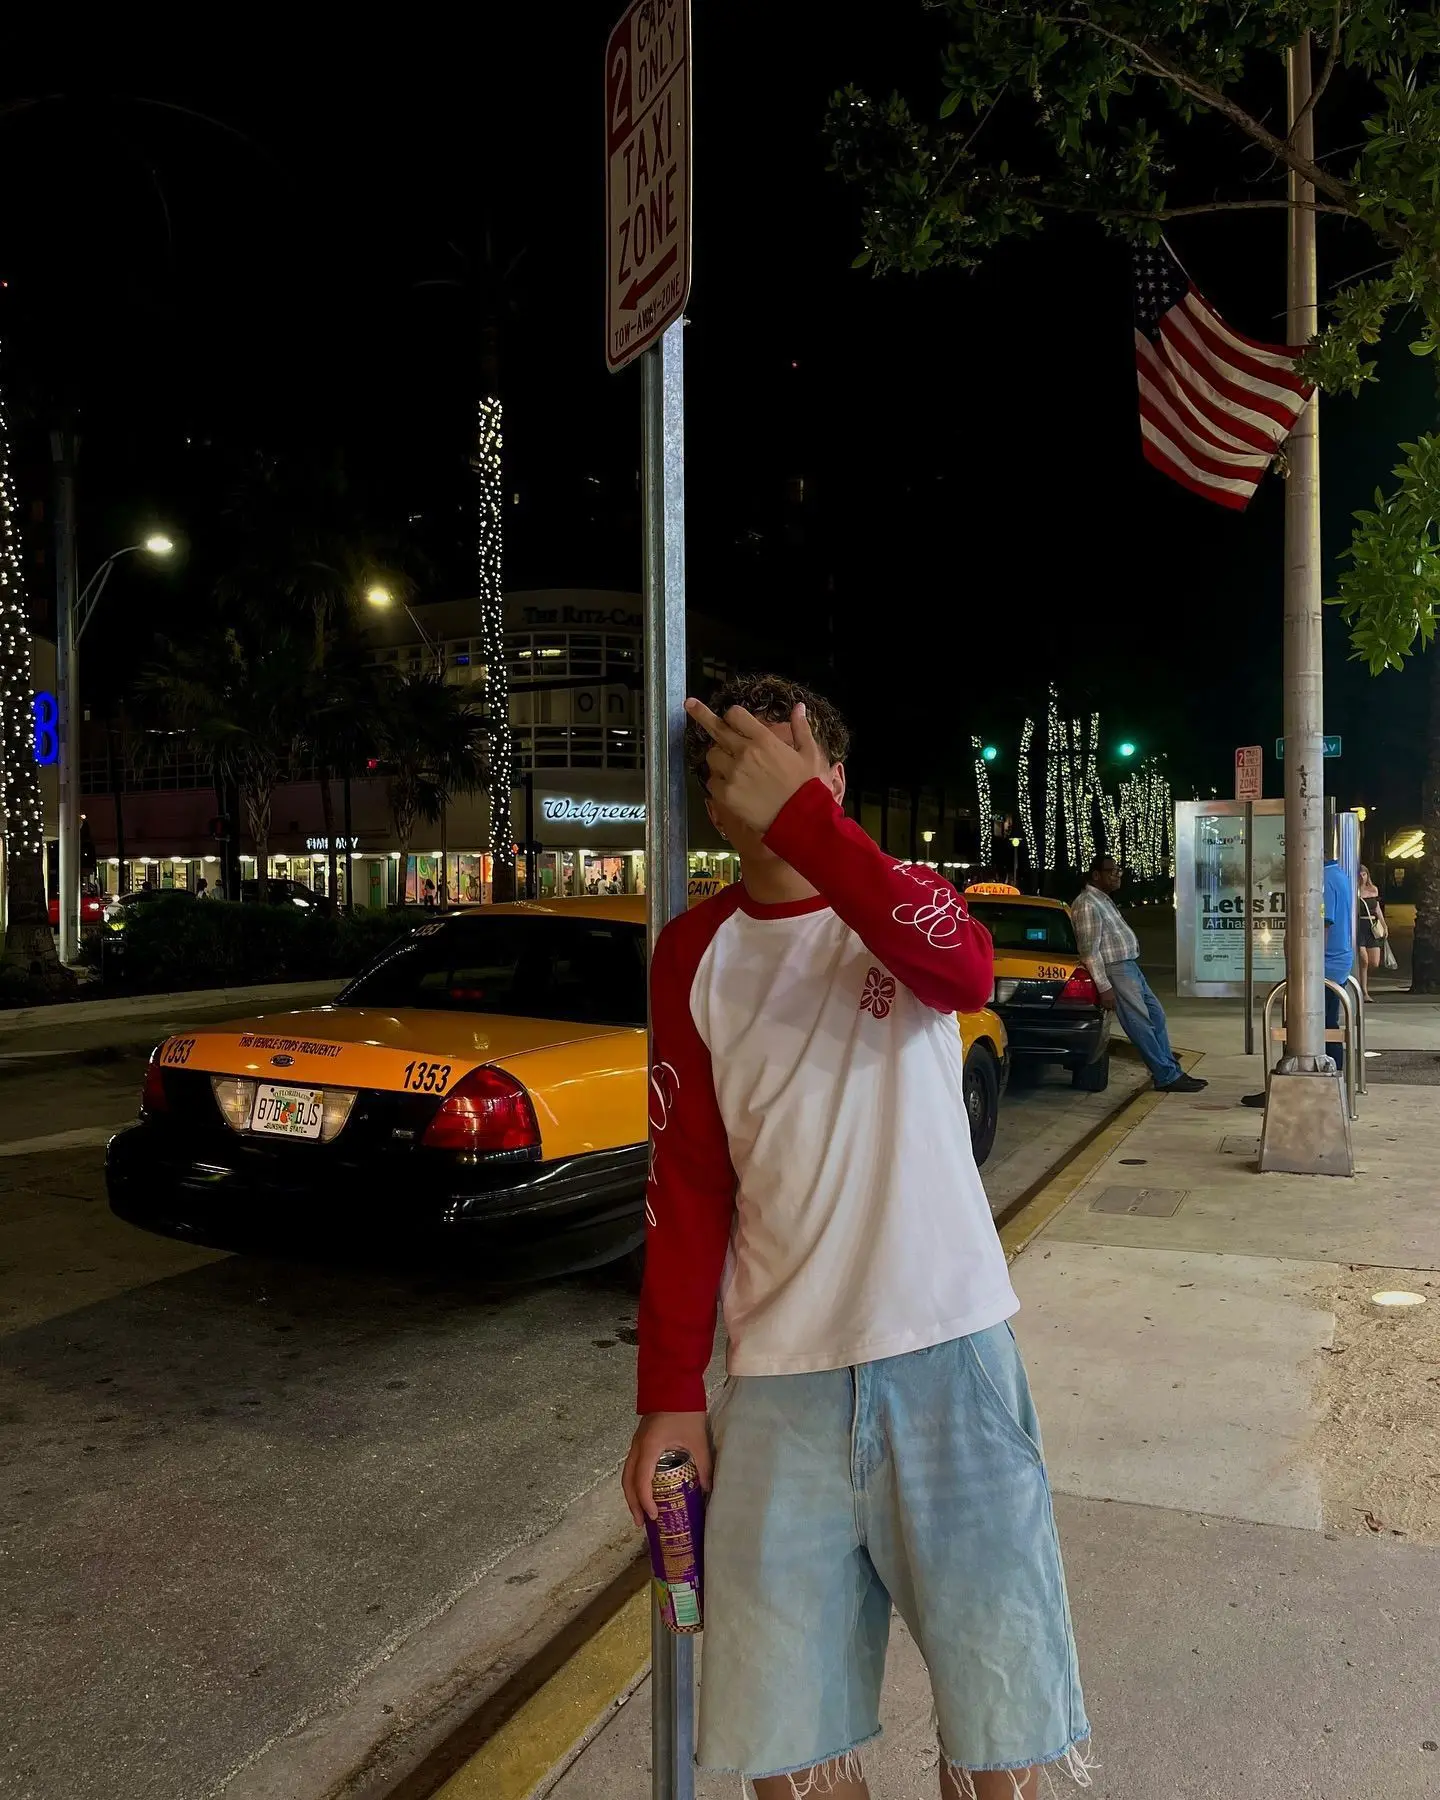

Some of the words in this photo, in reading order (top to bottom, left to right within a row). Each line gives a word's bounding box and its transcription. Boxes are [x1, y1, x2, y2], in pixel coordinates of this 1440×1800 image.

[638, 0, 674, 52] CAB
[638, 11, 677, 103] ONLY
[611, 46, 628, 134] 2
[623, 90, 672, 207] TAXI
[618, 162, 678, 285] ZONE
[614, 271, 681, 352] TOW-AWAY-ZONE
[32, 691, 59, 766] B
[1237, 752, 1244, 766] 2
[1239, 778, 1258, 790] ZONE
[1241, 768, 1257, 779] TAXI
[972, 885, 1012, 895] VACANT
[1202, 894, 1265, 914] Lets
[1206, 918, 1224, 929] Art
[1253, 919, 1268, 929] no
[1037, 965, 1067, 980] 3480
[163, 1038, 195, 1065] 1353
[239, 1036, 255, 1048] THIS
[252, 1037, 278, 1050] VEHICLE
[276, 1039, 300, 1052] STOPS
[297, 1041, 344, 1058] FREQUENTLY
[403, 1060, 452, 1093] 1353
[295, 1102, 320, 1126] BJS
[266, 1122, 289, 1132] SUNSHINE
[289, 1125, 305, 1134] STATE
